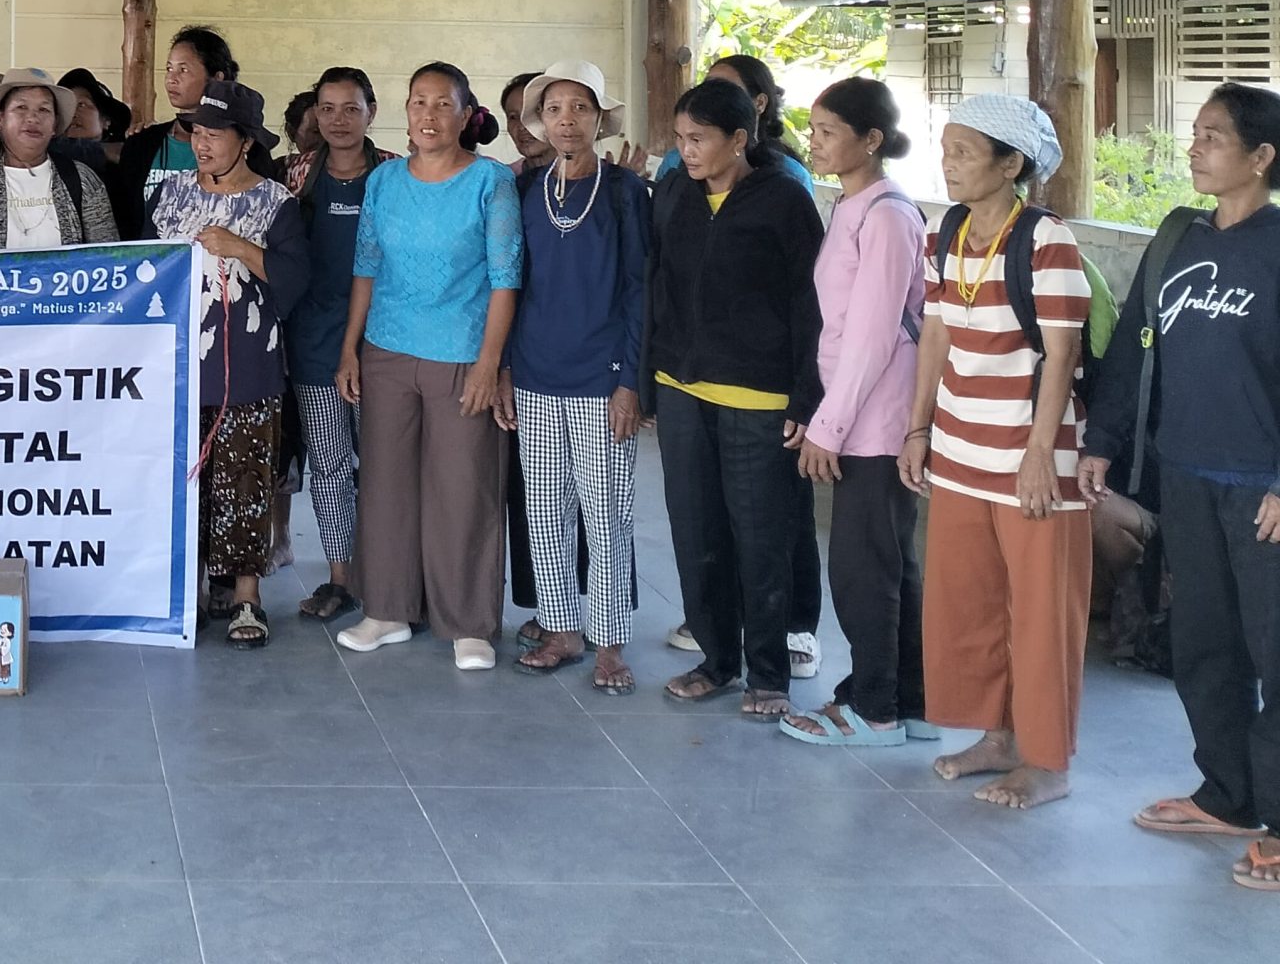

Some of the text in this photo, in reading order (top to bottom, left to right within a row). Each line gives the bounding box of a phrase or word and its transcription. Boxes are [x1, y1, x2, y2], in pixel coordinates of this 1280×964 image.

[52, 265, 128, 297] 2025
[1236, 287, 1247, 296] BE
[32, 302, 74, 315] Matius
[78, 301, 124, 314] 1:21-24
[1158, 261, 1255, 335] Grateful
